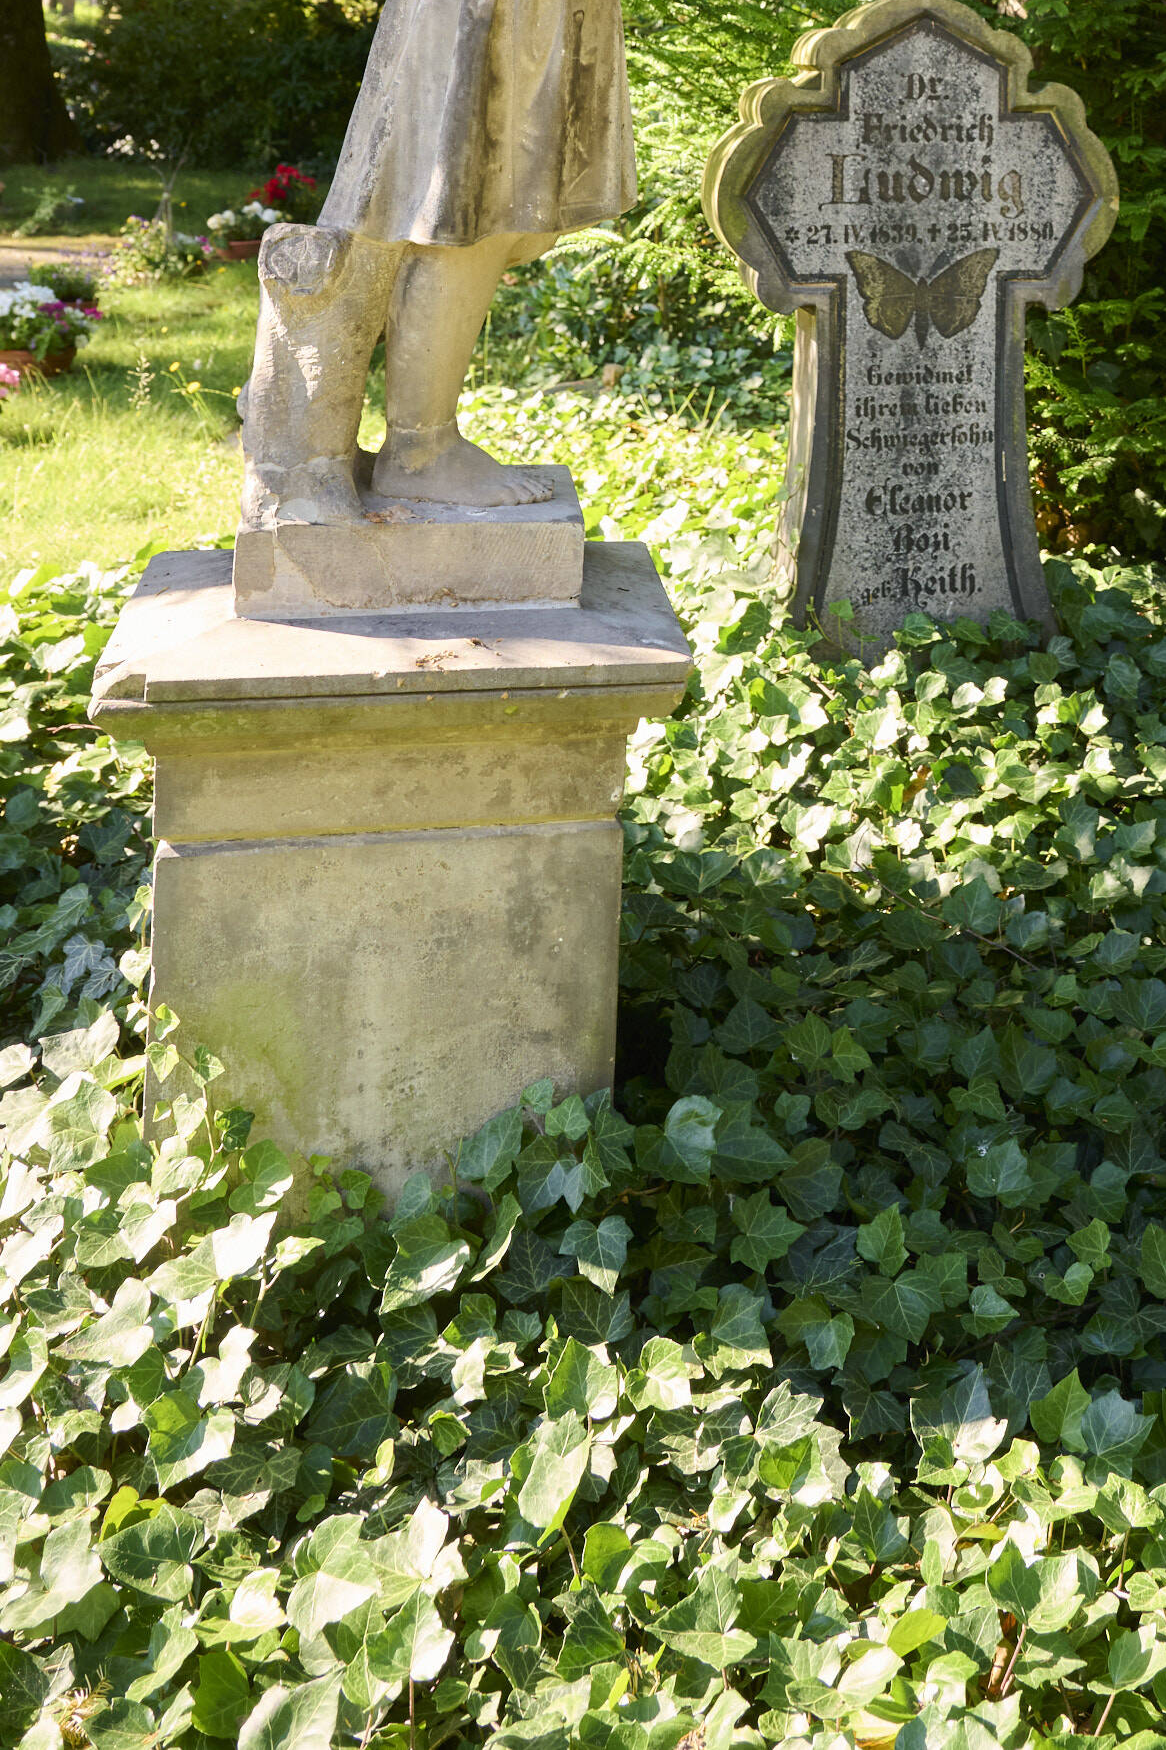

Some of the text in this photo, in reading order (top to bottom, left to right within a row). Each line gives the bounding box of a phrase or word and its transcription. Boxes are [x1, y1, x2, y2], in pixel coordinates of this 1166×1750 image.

[903, 73, 949, 100] Dr.
[860, 114, 994, 147] Friedrich
[818, 153, 1027, 218] Ludwig
[806, 226, 838, 244] 27.
[855, 395, 987, 420] ihrem lieben
[903, 460, 939, 476] von
[865, 478, 973, 517] Eleanor
[887, 522, 950, 558] Bozi
[897, 563, 983, 608] Keith.
